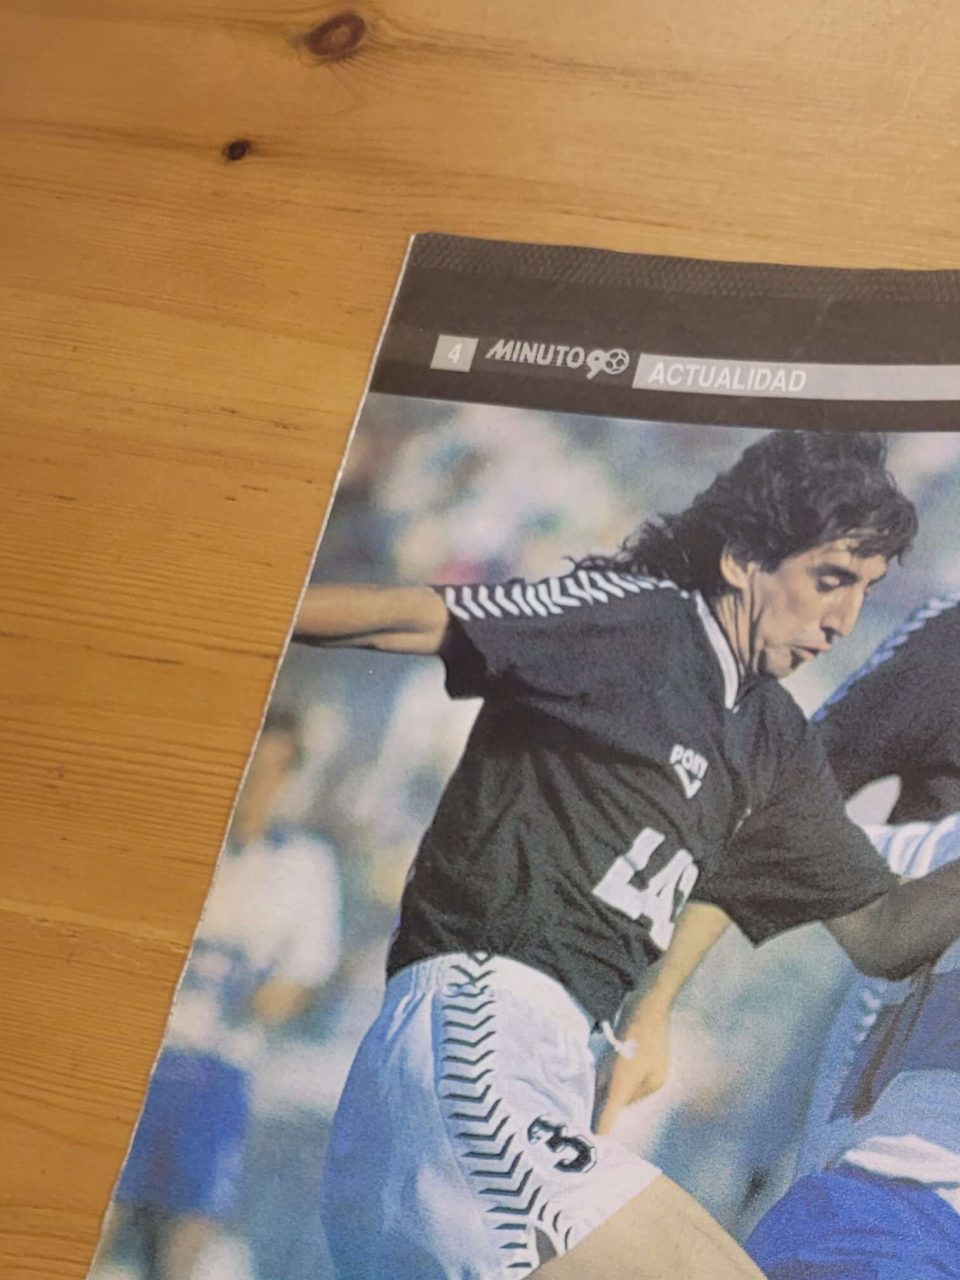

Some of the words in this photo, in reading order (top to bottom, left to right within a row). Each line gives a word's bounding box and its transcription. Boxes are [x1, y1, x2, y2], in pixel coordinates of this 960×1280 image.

[447, 343, 462, 364] 4
[648, 362, 807, 392] ACTUALIDAD
[527, 1114, 597, 1174] 3
